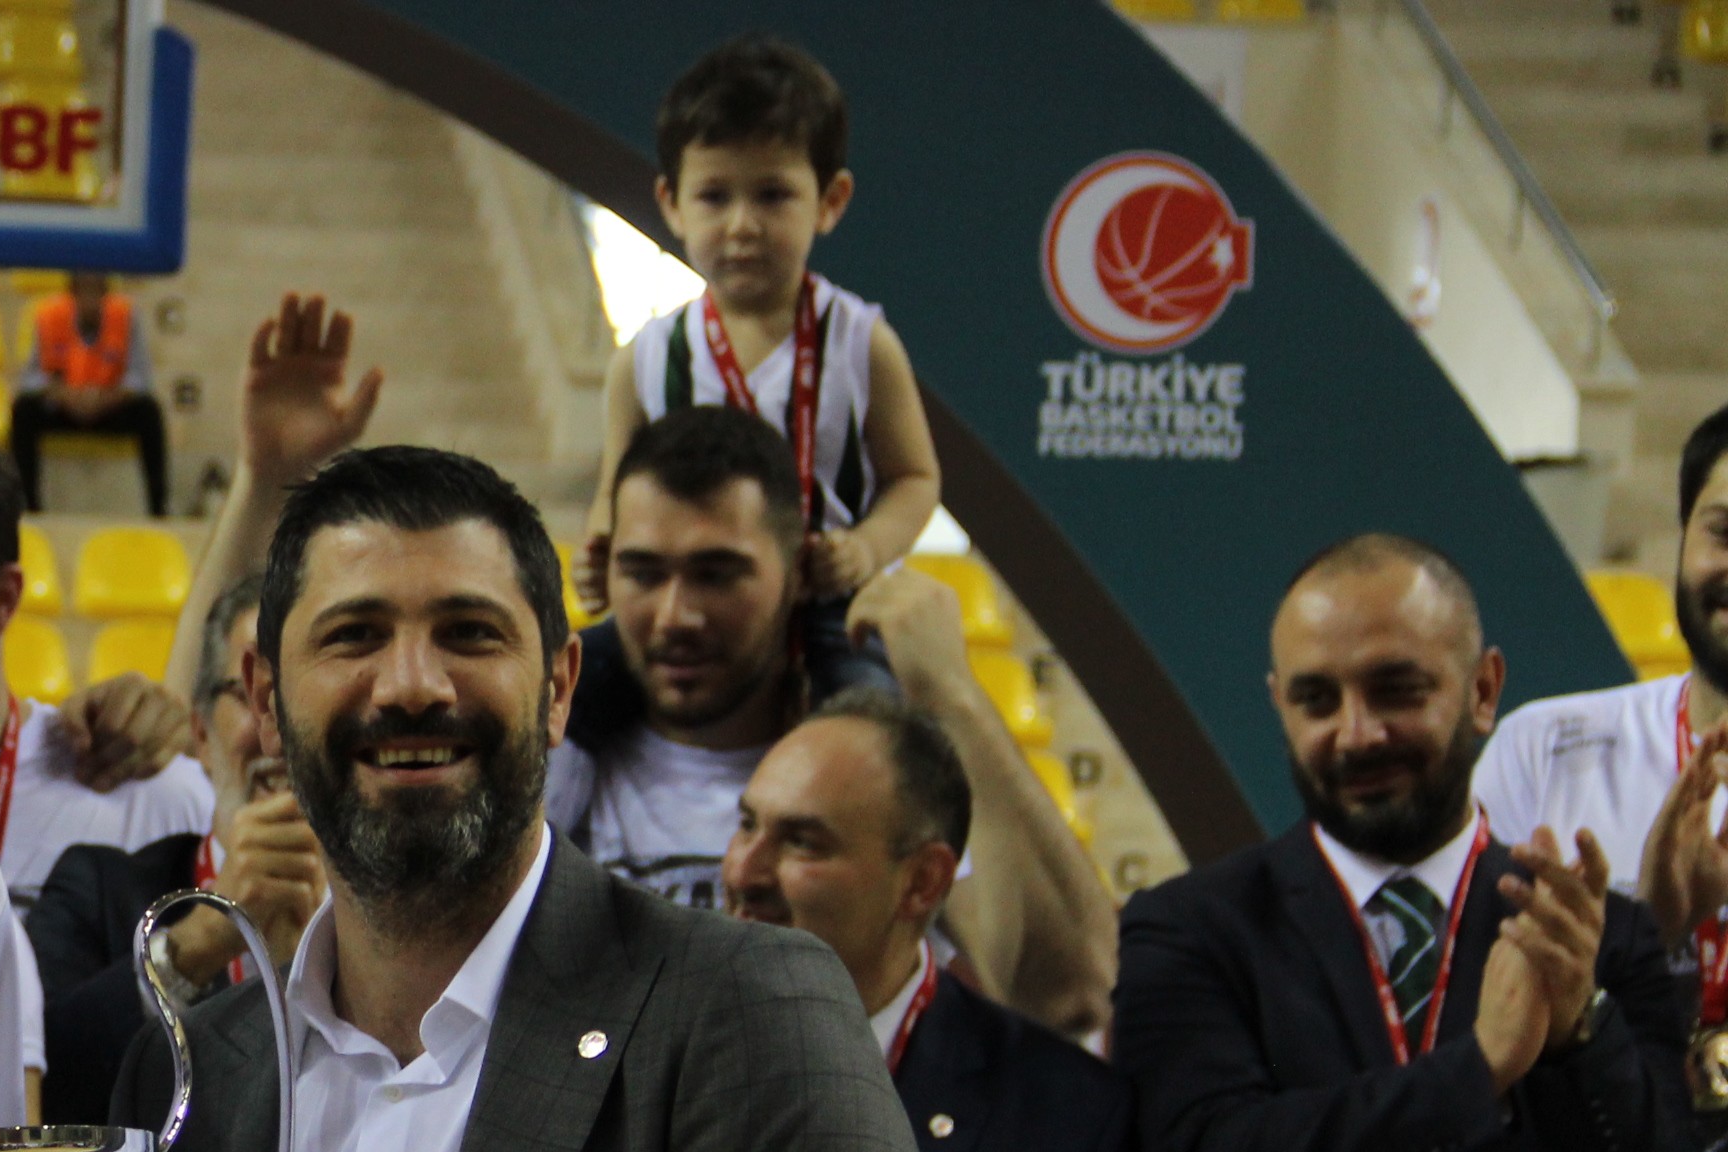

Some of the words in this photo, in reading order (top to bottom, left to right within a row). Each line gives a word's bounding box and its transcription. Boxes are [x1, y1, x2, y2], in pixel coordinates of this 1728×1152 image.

[1041, 353, 1246, 404] TÜRKİYE
[1039, 403, 1244, 432] BASKETBOL
[1038, 432, 1243, 460] FEDERASYONU
